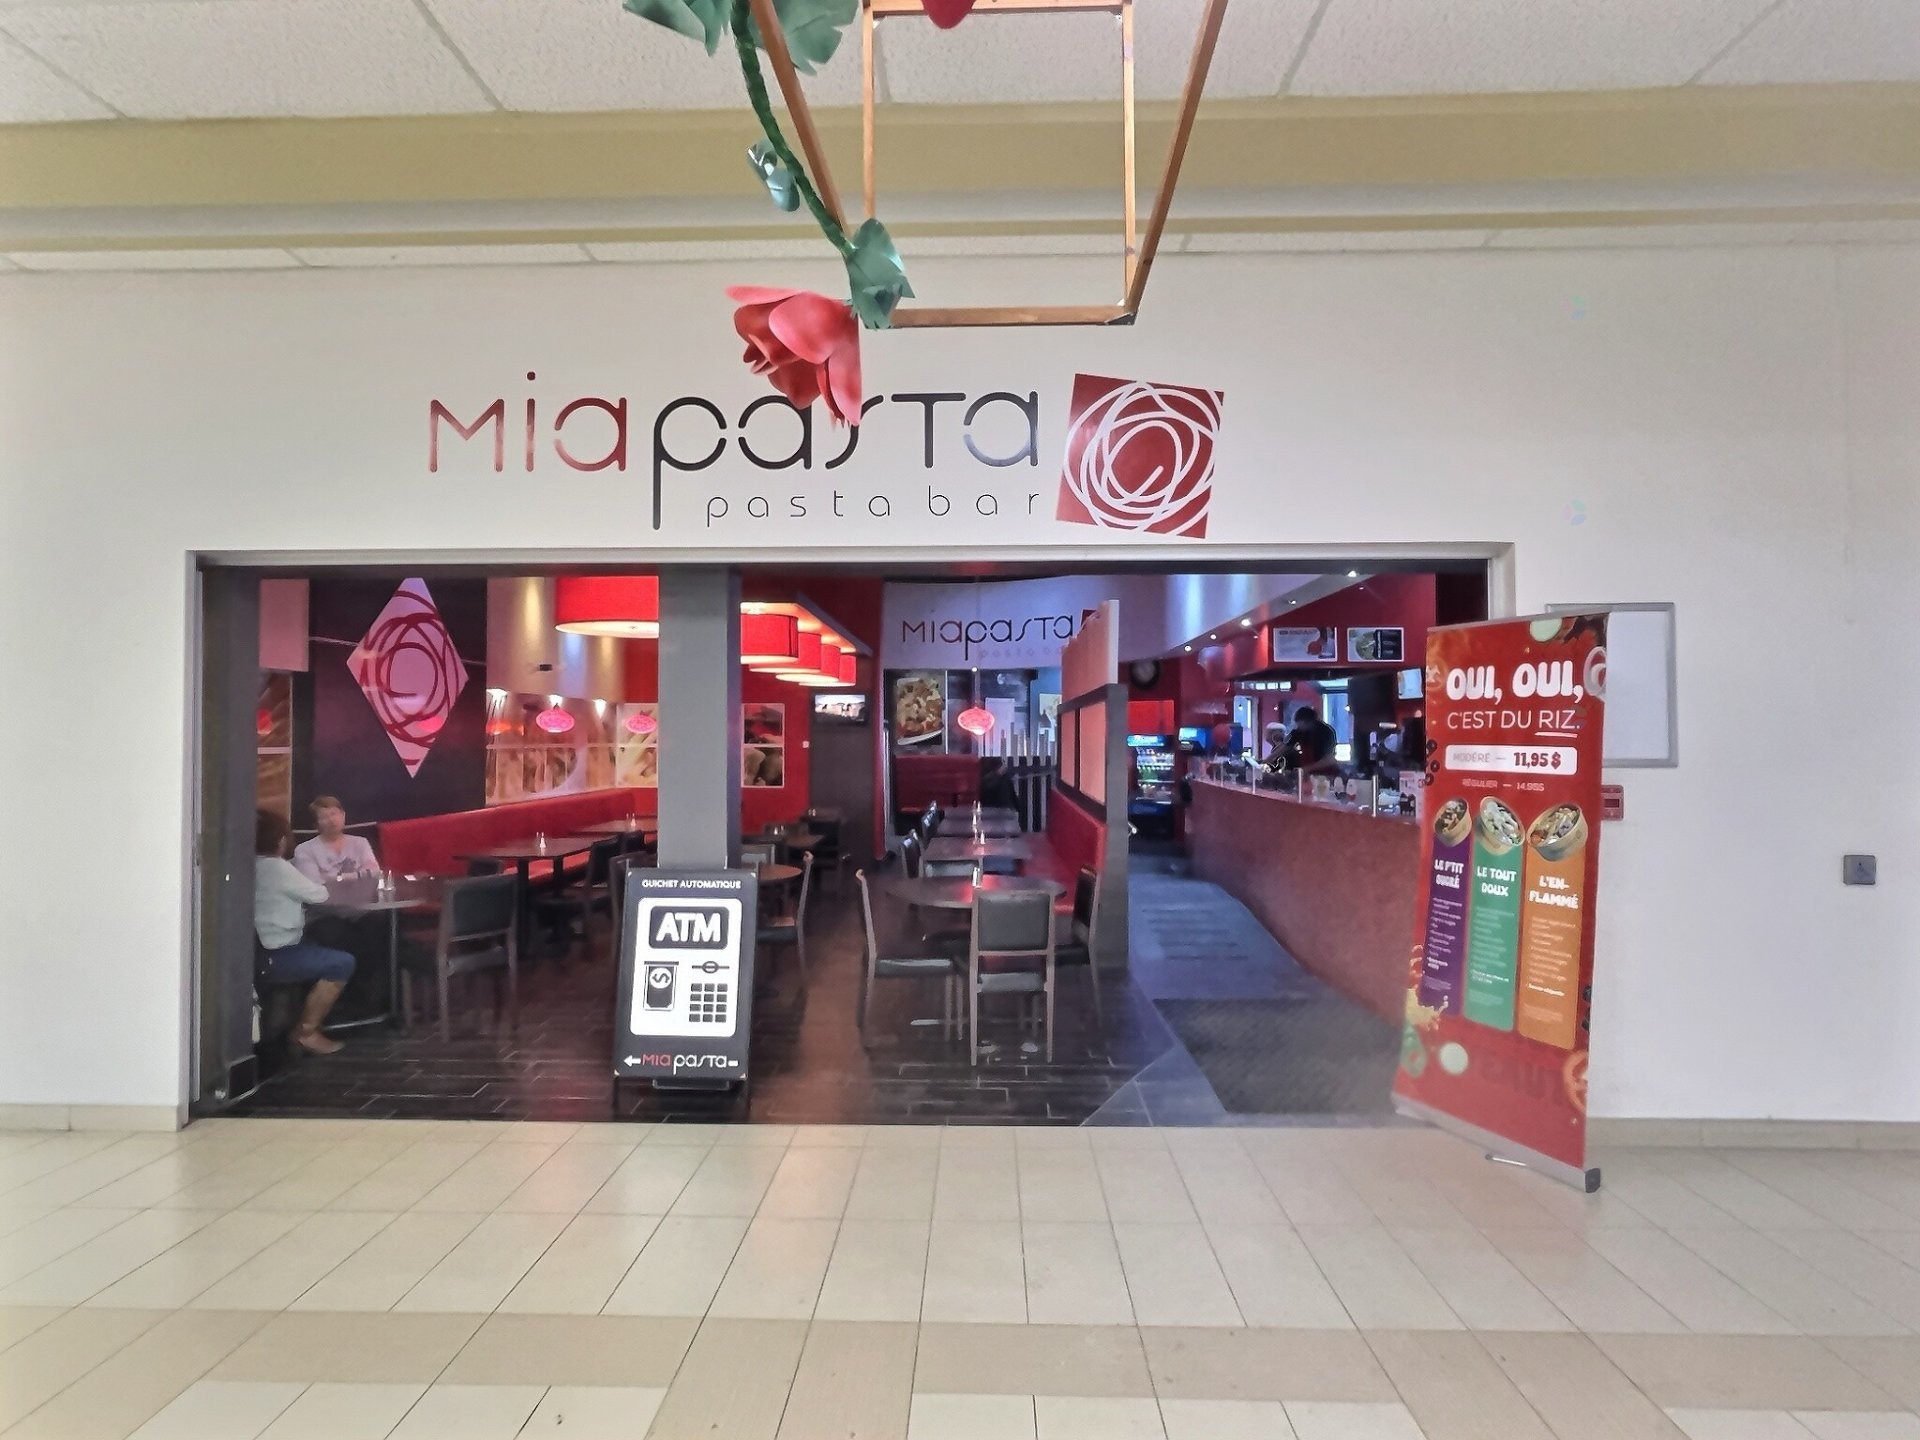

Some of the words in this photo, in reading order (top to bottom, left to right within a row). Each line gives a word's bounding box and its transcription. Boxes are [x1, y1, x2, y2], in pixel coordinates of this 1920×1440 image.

[707, 489, 890, 528] pasta
[928, 485, 1039, 518] bar
[1446, 665, 1503, 705] OUI,
[1512, 660, 1584, 704] OUI,
[1447, 710, 1497, 730] C'EST
[1500, 710, 1532, 729] DU
[1539, 709, 1581, 730] RIZ.
[1477, 866, 1487, 878] LE
[1489, 868, 1517, 882] TOUT
[641, 879, 679, 889] GUICHET
[680, 879, 741, 890] AUTOMATIQUE
[1481, 882, 1509, 897] DOUX
[1529, 890, 1579, 909] FLAMMÉ
[656, 912, 721, 943] ATM
